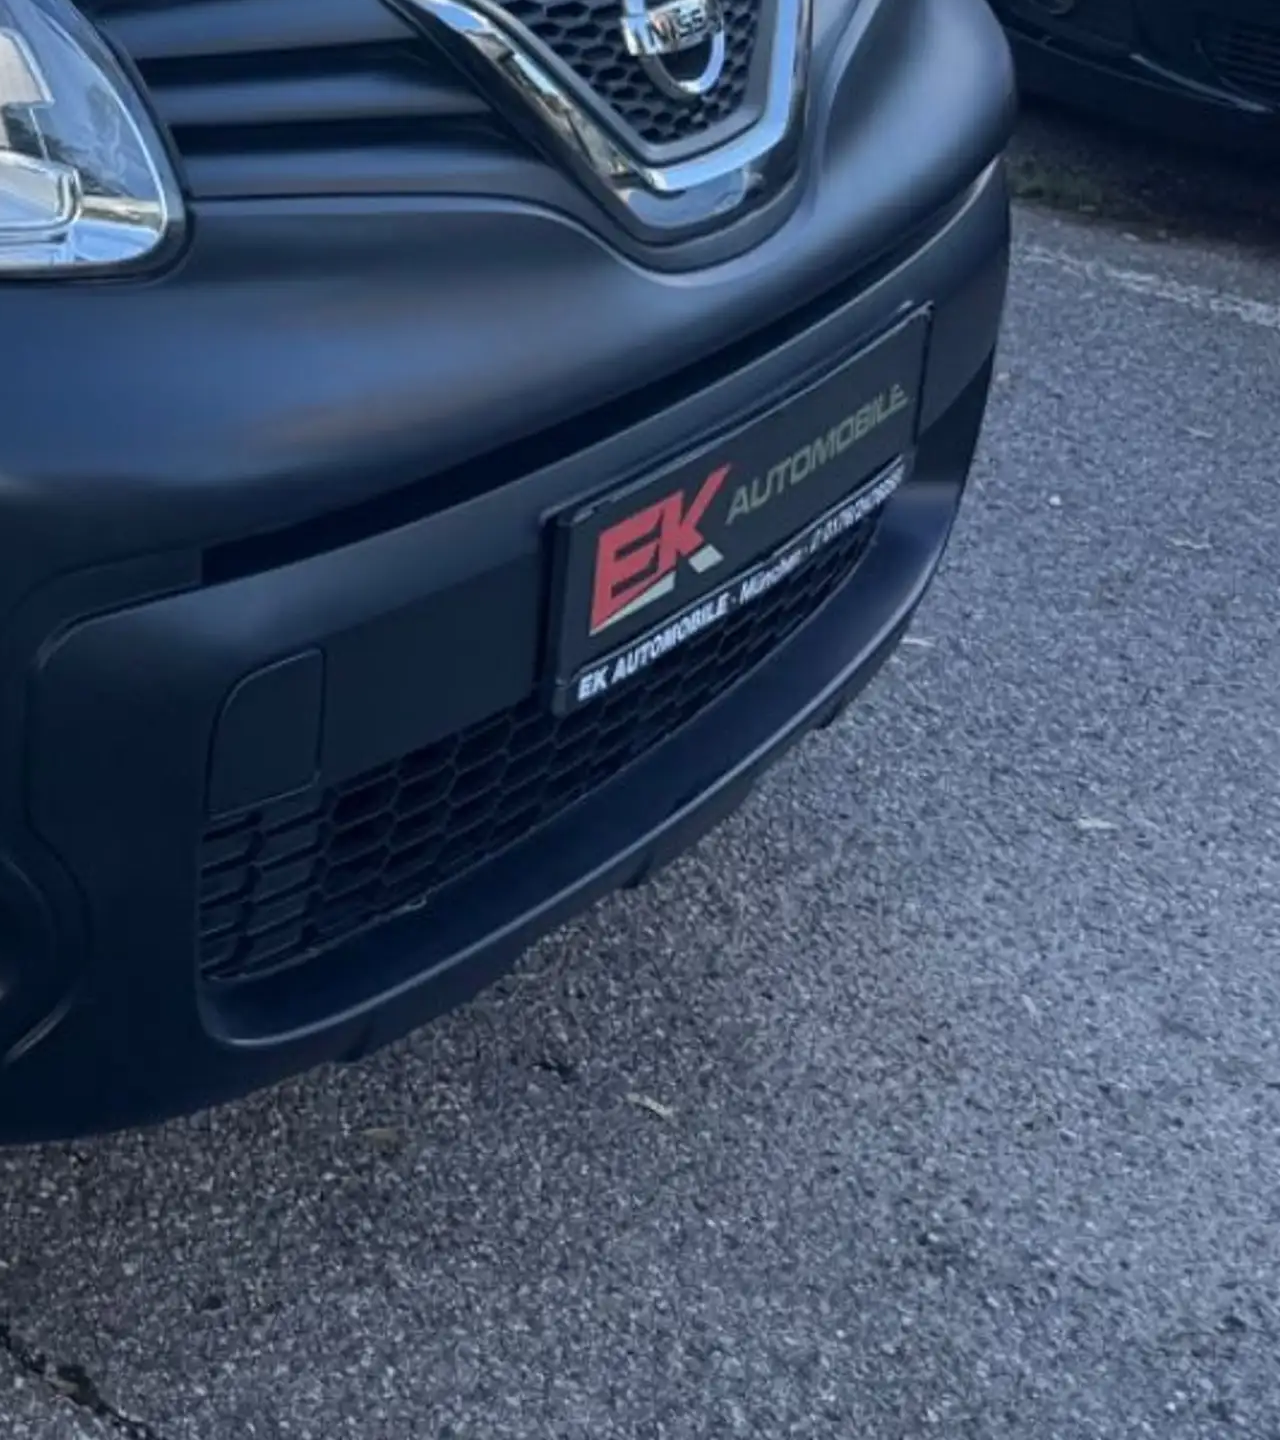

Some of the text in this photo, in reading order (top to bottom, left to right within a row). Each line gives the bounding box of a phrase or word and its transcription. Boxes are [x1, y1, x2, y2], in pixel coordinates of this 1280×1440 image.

[589, 463, 732, 635] EK
[725, 383, 909, 526] AUTOMOBILE
[577, 664, 609, 702] EK
[612, 592, 731, 684] AUTOMOBILE
